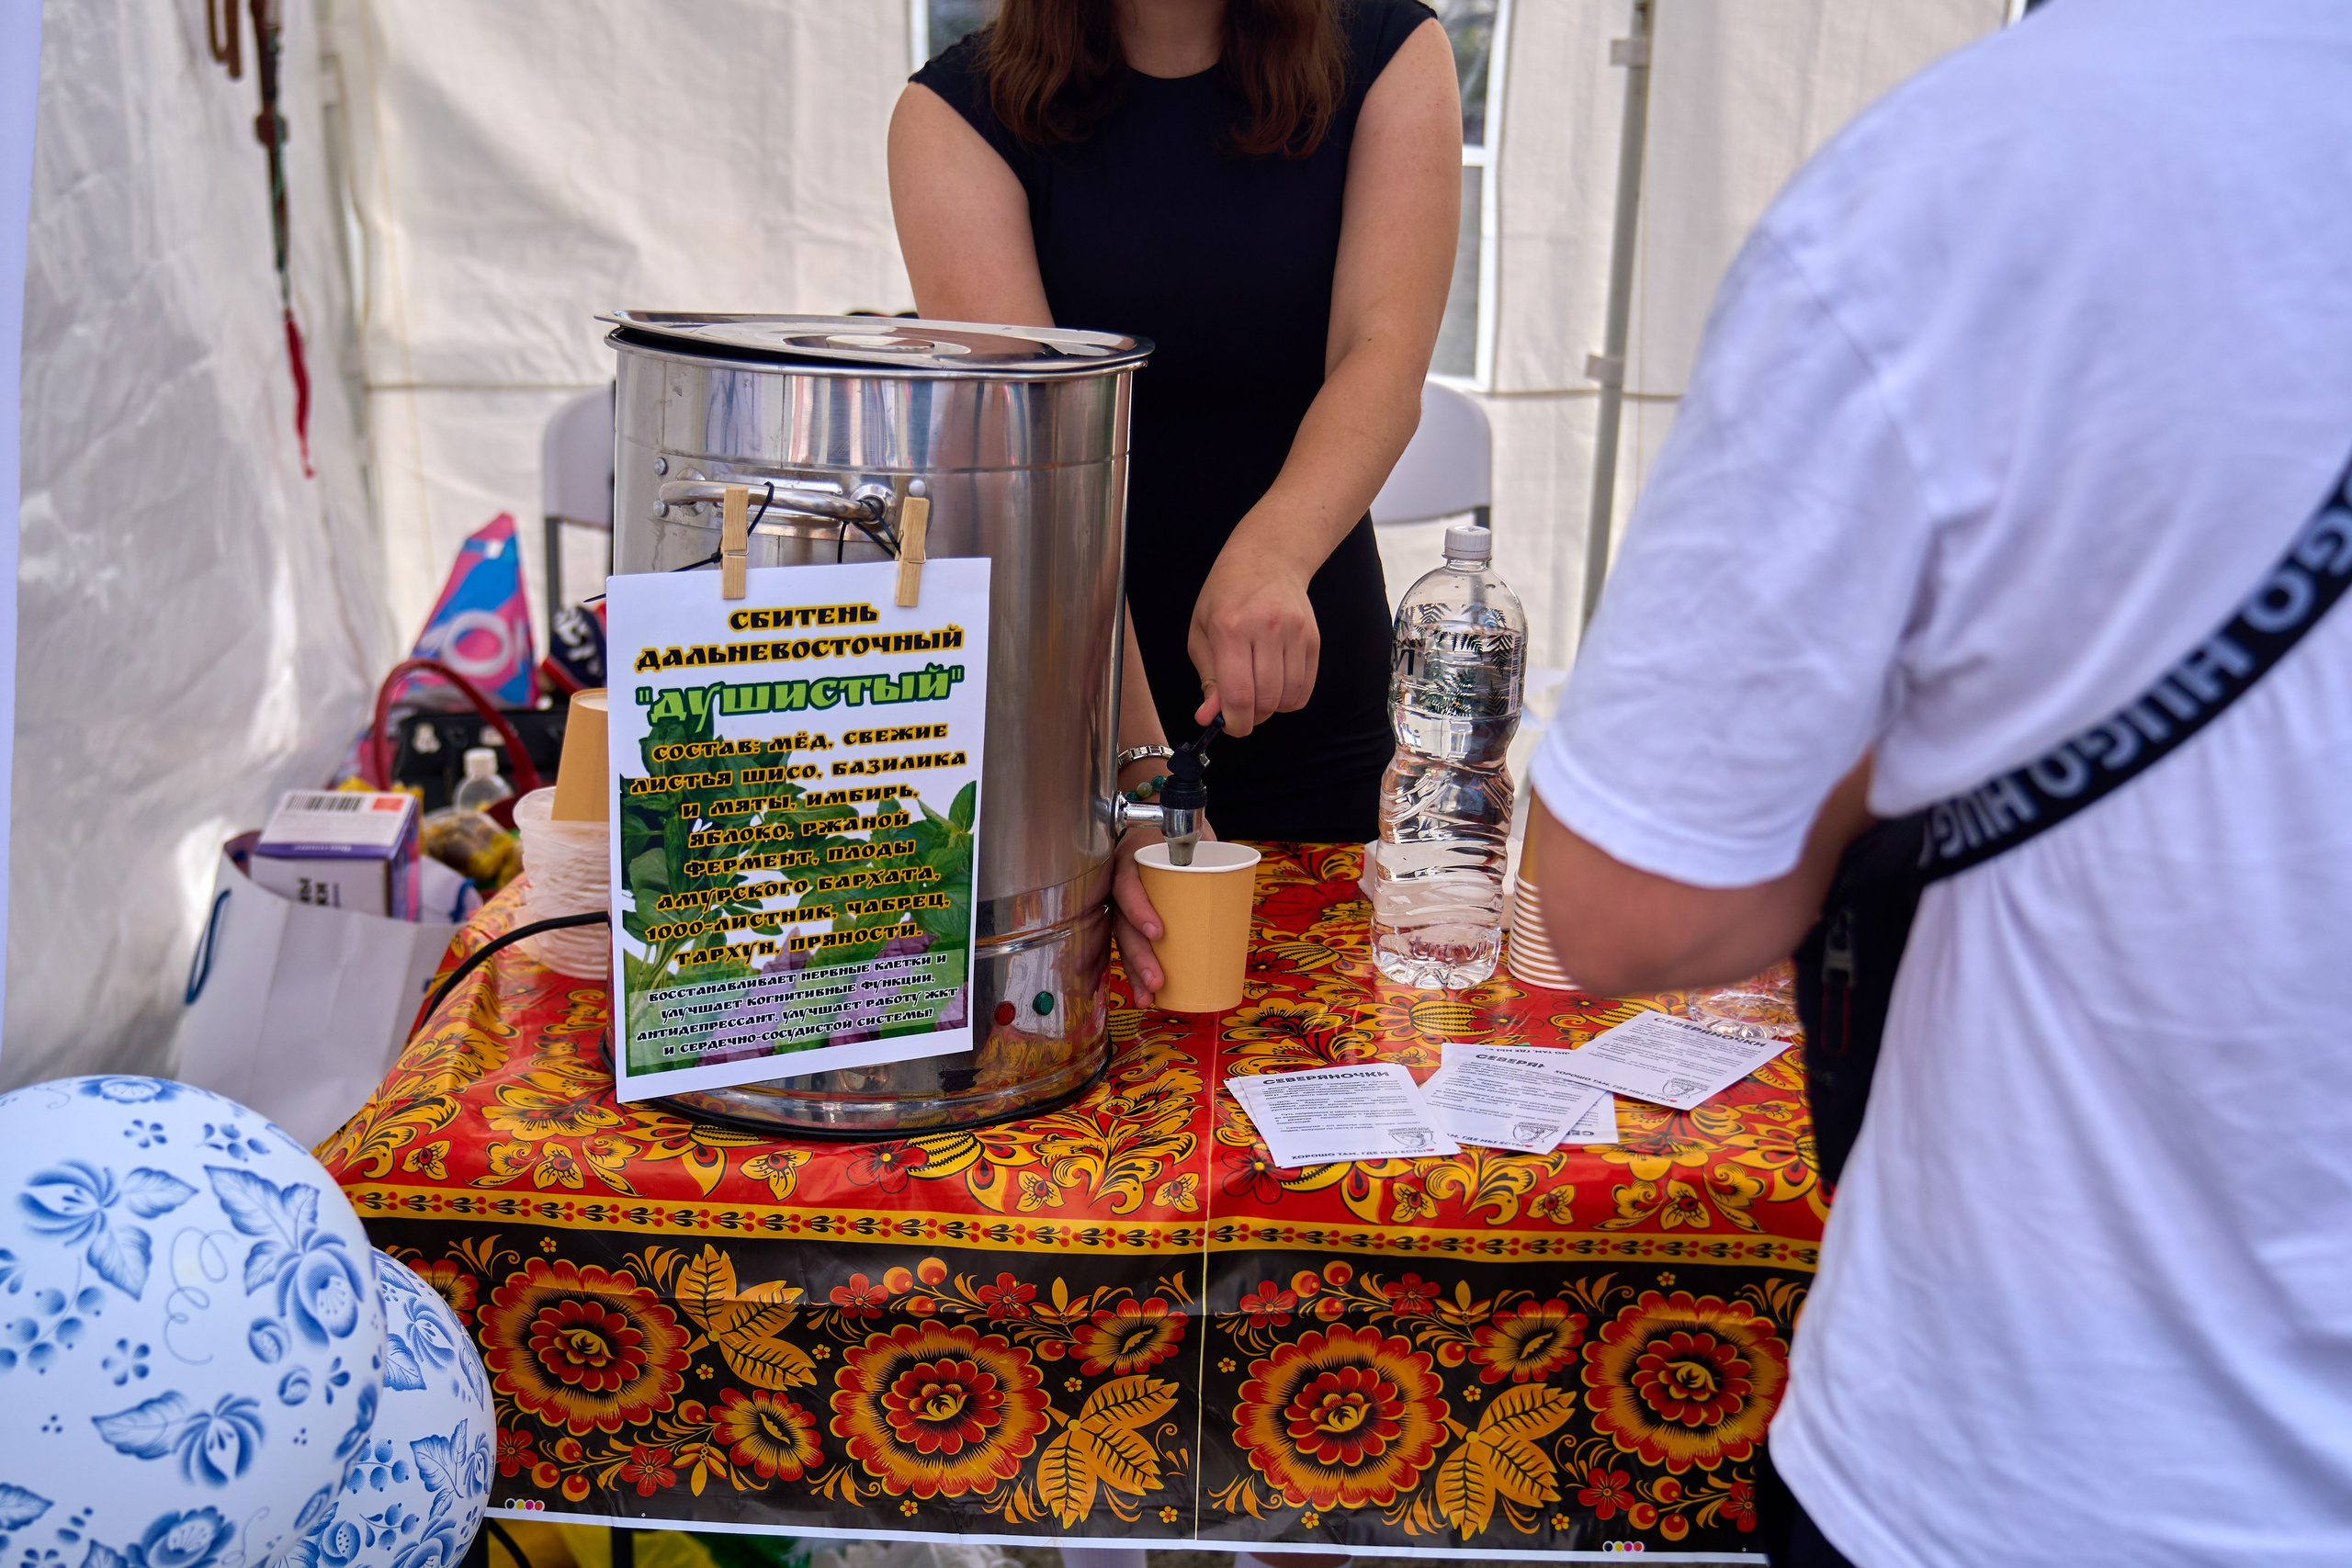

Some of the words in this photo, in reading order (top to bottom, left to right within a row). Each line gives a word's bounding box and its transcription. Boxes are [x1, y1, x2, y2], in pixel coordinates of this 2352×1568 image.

[729, 603, 879, 632] СБИТЕНЬ
[635, 625, 965, 672] ДАЛЬНЕВОСТОЧНЫЙ
[636, 663, 965, 733] "ДУШИСТЫЙ"
[2026, 634, 2256, 800] HUGO
[652, 738, 761, 761] СОСТАВ:
[768, 732, 834, 753] МЁД,
[842, 723, 948, 746] СВЕЖИЕ
[630, 771, 732, 795] ЛИСТЬЯ
[741, 762, 822, 784] ШИСО,
[831, 750, 967, 777] БАЗИЛИКА
[682, 803, 700, 820] И
[708, 792, 796, 817] МЯТЫ,
[805, 783, 919, 809] ИМБИРЬ,
[687, 823, 794, 849] ЯБЛОКО,
[801, 809, 910, 836] РЖАНОЙ
[684, 849, 820, 878] ФЕРМЕНТ,
[827, 838, 916, 863] ПЛОДЫ
[656, 879, 808, 913] АМУРСКОГО
[818, 865, 941, 892] БАРХАТА,
[644, 906, 837, 942] 1000-ЛИСТНИК,
[846, 892, 951, 917] ЧАБРЕЦ,
[673, 938, 780, 968] ТАРХУН,
[788, 922, 923, 953] ПРЯНОСТИ.
[649, 973, 797, 1003] ВОССТАНАВЛИВАЕТ
[801, 963, 871, 983] НЕРВНЫЕ
[874, 955, 932, 973] КЛЕТКИ
[936, 953, 947, 964] И
[662, 998, 741, 1023] УЛУЧШАЕТ
[746, 982, 856, 1008] КОГНИТИВНЫЕ
[783, 999, 862, 1023] УЛУЧШАЕТ
[865, 991, 921, 1010] РАБОТУ
[924, 987, 958, 1000] ЖКТ
[663, 1045, 675, 1056] И
[680, 1018, 853, 1055] СЕРДЕЧНО-СОСУДИСТОЙ
[856, 1008, 934, 1029] СИСТЕМЫ!
[1653, 1017, 1767, 1047] СЕВЕРЯНОЧКИ
[1262, 1071, 1390, 1085] СЕВЕРЯНОЧКИ
[1292, 1152, 1335, 1160] ХОРОШО
